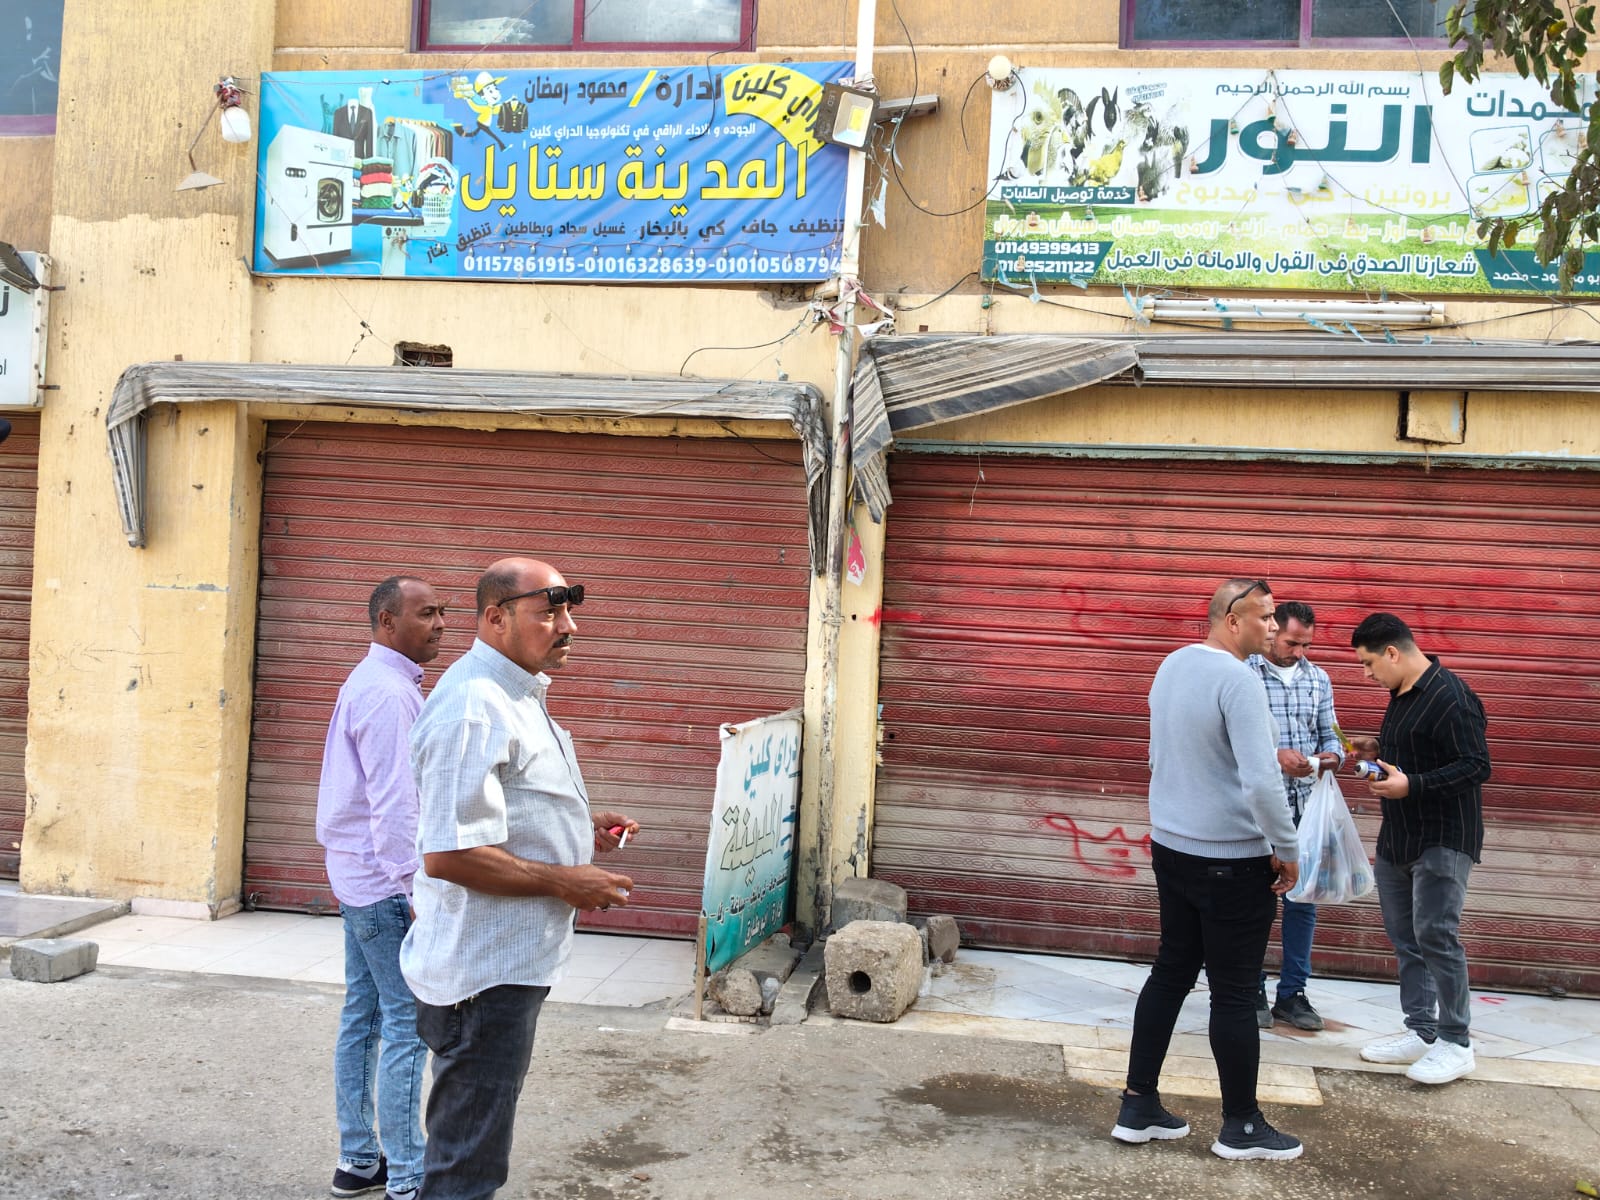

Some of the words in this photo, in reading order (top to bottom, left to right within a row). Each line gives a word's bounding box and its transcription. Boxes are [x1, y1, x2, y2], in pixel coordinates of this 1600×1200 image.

[524, 74, 569, 105] رمضان
[577, 80, 628, 105] محمود
[656, 73, 722, 108] ادارة
[732, 70, 791, 102] كلين
[1215, 81, 1273, 97] الرحيم
[1277, 81, 1334, 97] الرحمن
[1338, 80, 1364, 95] الله
[1368, 84, 1410, 98] بسم
[782, 96, 821, 133] راي
[529, 124, 552, 140] كلين
[554, 124, 583, 141] الدراي
[585, 124, 630, 140] تكنولوجيا
[633, 124, 649, 141] في
[652, 124, 682, 141] الراقي
[723, 122, 756, 138] الجوده
[1191, 103, 1433, 175] النور
[460, 143, 607, 217] ستايل
[616, 140, 808, 218] المدينة
[1003, 188, 1047, 202] الطلبات
[1051, 188, 1094, 203] توصيل
[1097, 187, 1131, 200] خدمة
[504, 221, 553, 238] وبطاطين
[558, 220, 588, 236] سجاد
[592, 221, 626, 238] غسيل
[639, 220, 688, 240] بالبخار
[698, 219, 726, 242] كي
[741, 218, 778, 236] جاف
[789, 218, 844, 237] تنظيف
[994, 241, 1099, 255] 01149399413
[1107, 248, 1161, 272] العمل
[1164, 251, 1193, 271] فى
[1198, 250, 1262, 273] والامانه
[1266, 251, 1314, 274] القول
[1319, 252, 1347, 275] فى
[1352, 253, 1411, 276] الصدق
[1415, 253, 1477, 279] شعارنا
[1493, 271, 1529, 282] محمد
